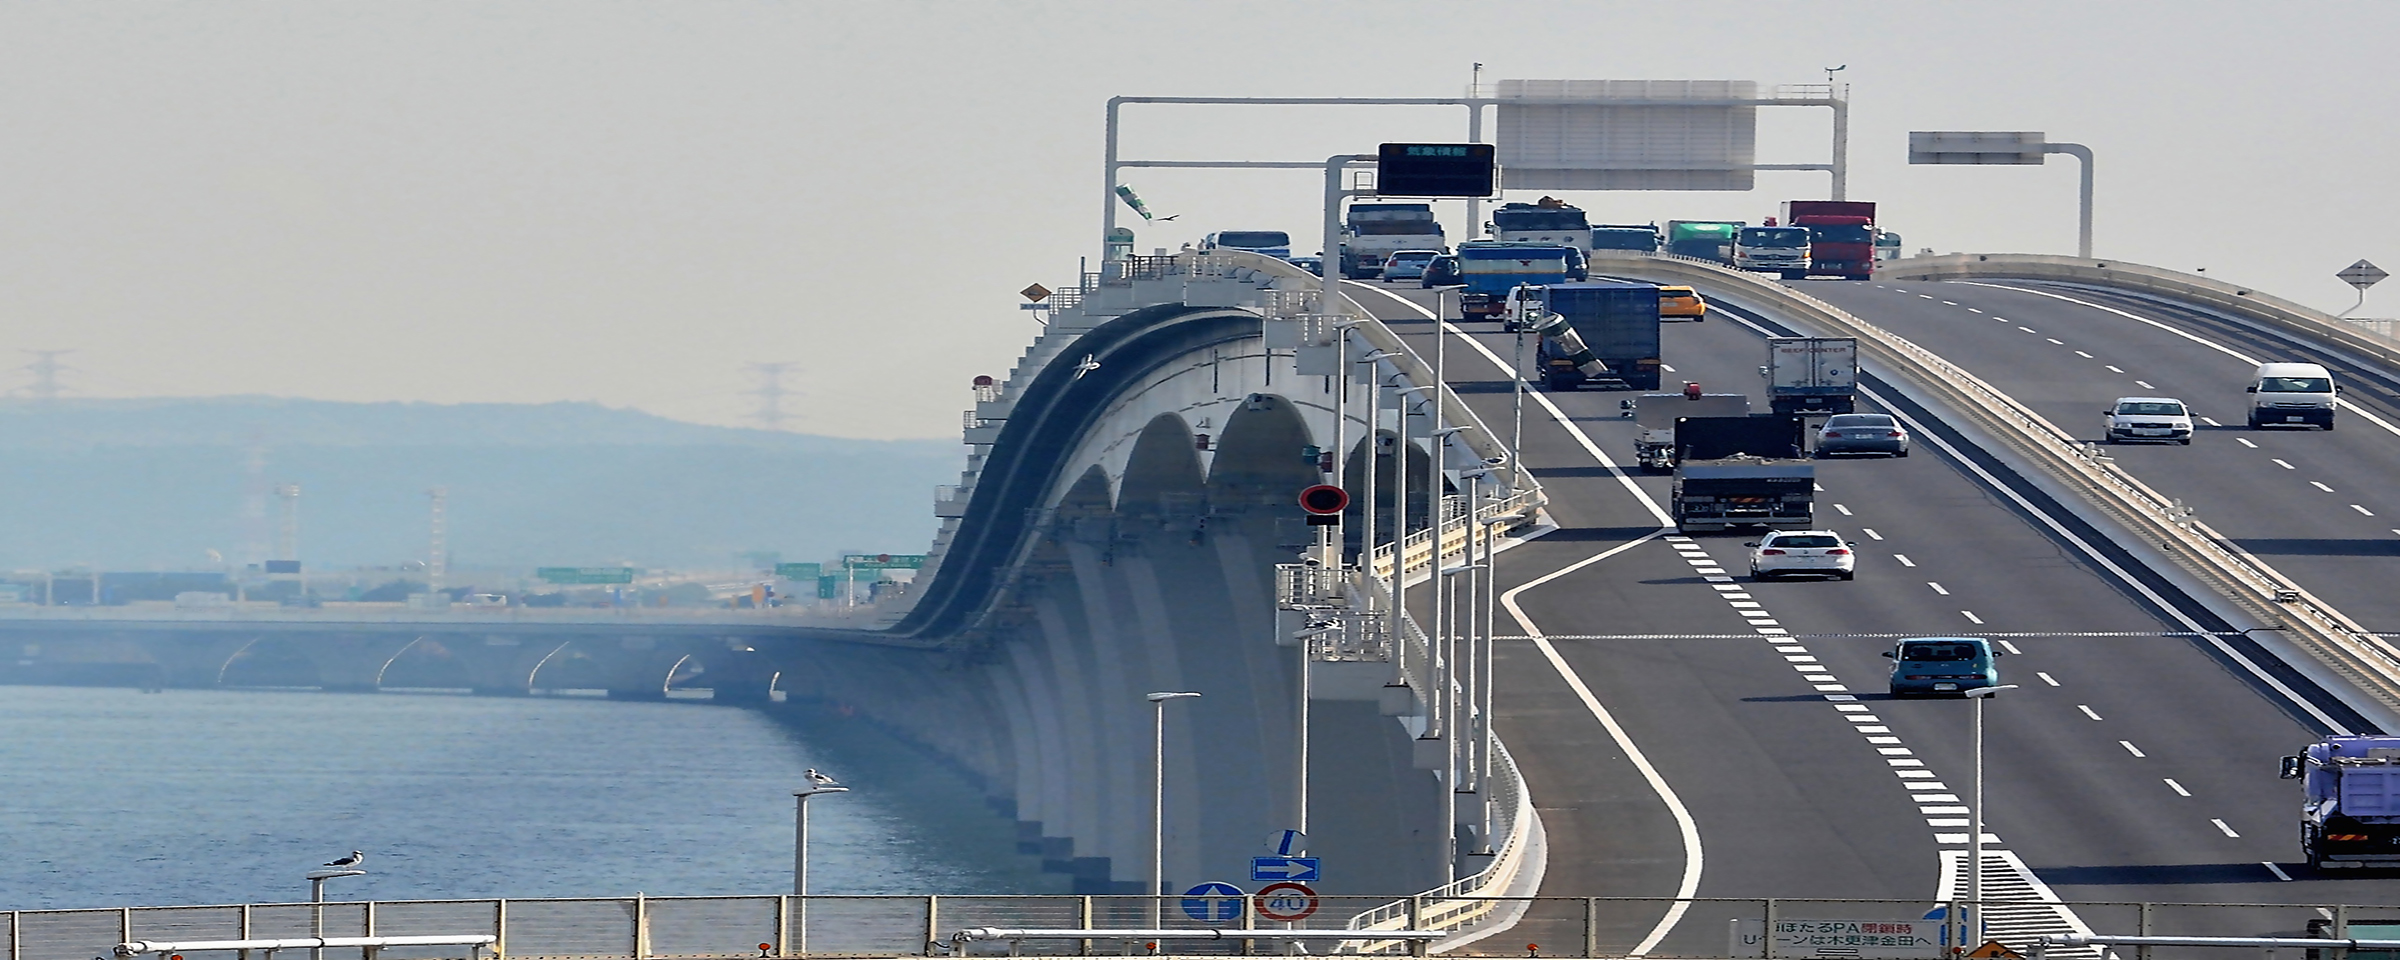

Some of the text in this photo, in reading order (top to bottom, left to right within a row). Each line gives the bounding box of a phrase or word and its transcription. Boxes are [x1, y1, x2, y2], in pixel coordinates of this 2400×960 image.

[1269, 893, 1304, 911] 40
[1743, 935, 1931, 946] Uーンは木更津金田へ
